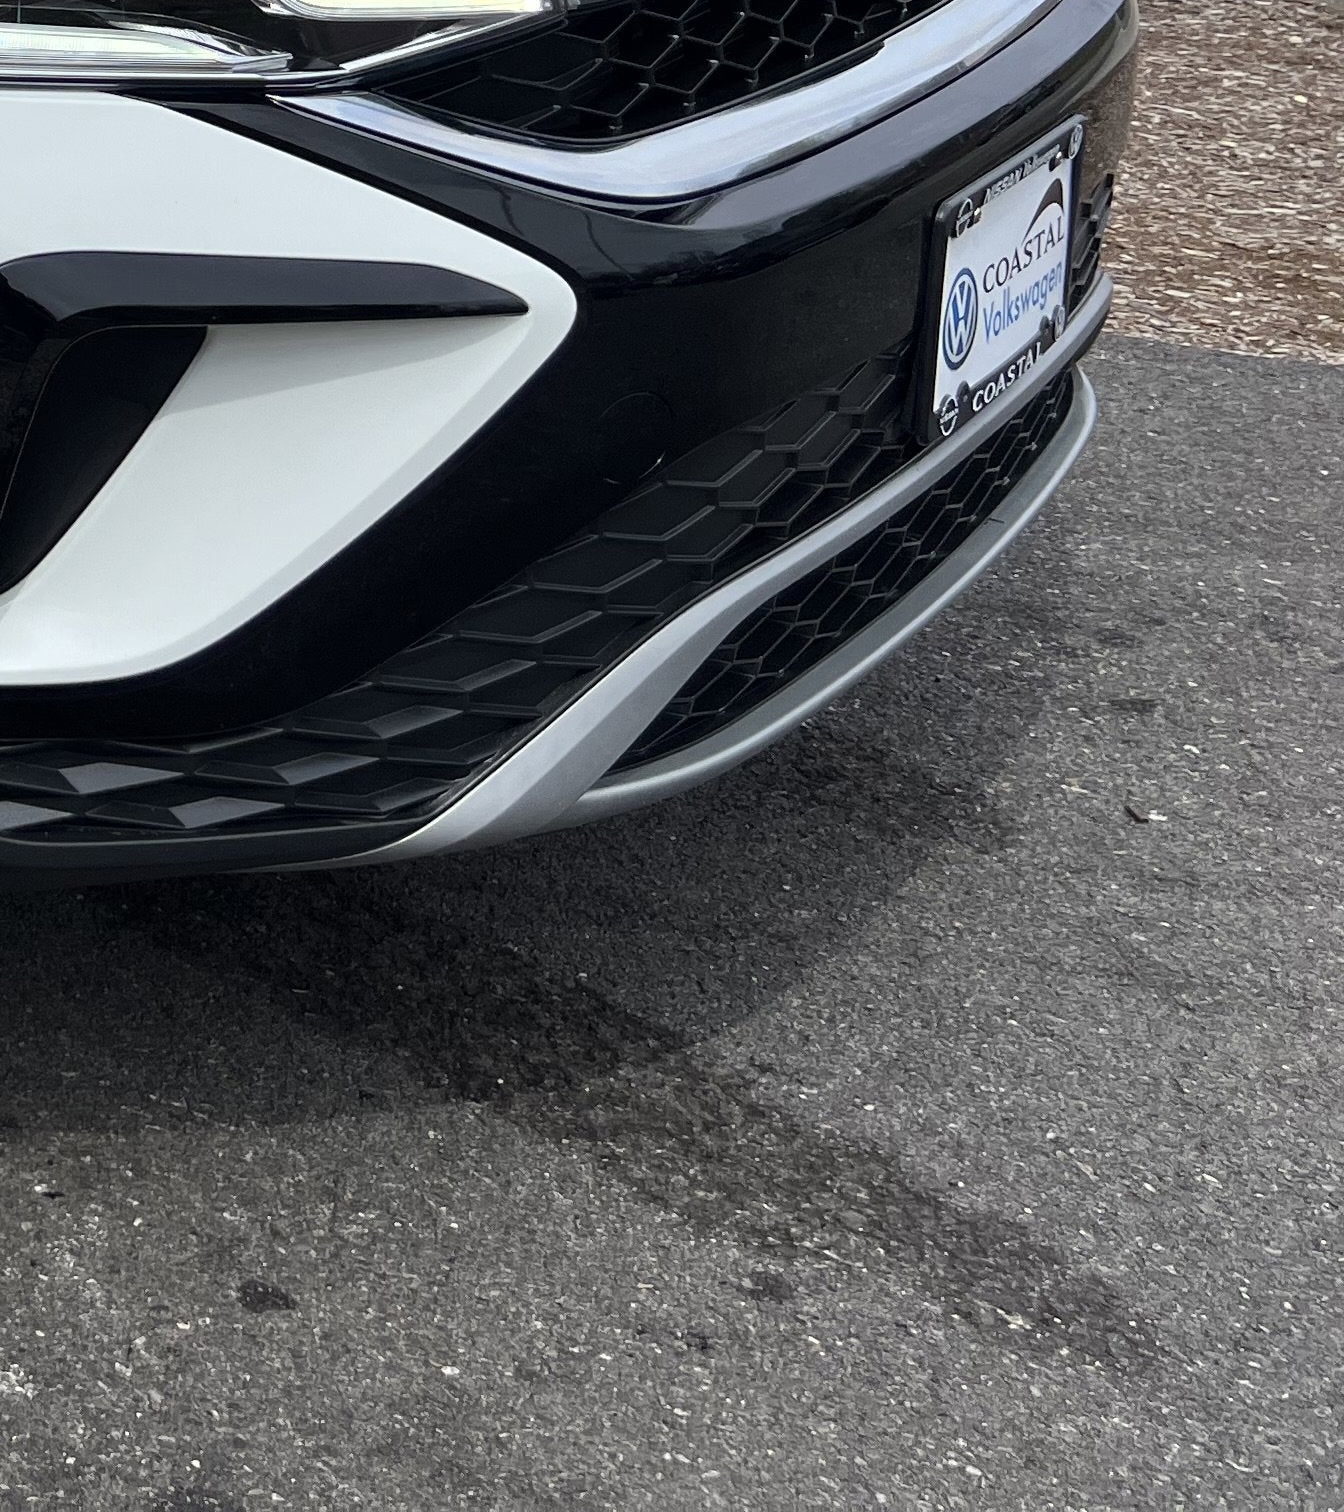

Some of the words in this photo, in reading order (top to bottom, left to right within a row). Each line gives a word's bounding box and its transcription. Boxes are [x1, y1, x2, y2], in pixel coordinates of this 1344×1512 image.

[982, 215, 1065, 294] COASTAL
[982, 261, 1063, 345] Volkswagen
[972, 341, 1041, 412] COASTAL
